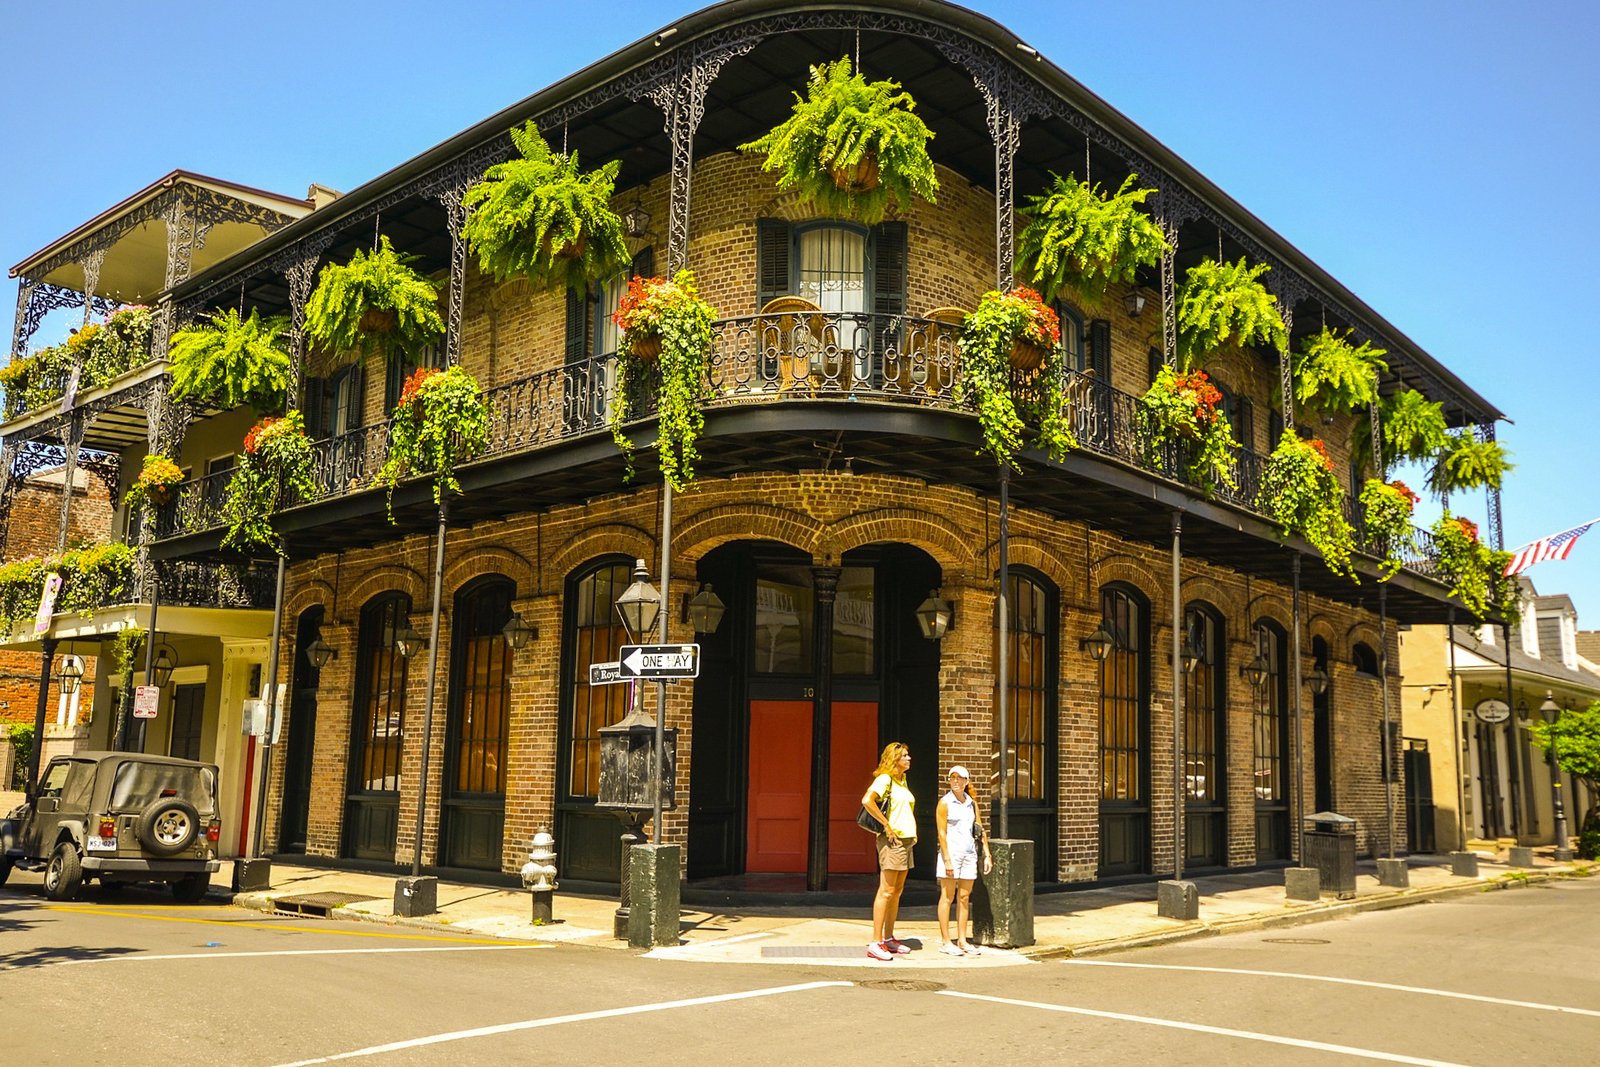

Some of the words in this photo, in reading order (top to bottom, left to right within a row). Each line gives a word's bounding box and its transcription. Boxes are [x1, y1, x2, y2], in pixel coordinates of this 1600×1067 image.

[642, 655, 663, 668] ONE
[600, 669, 620, 682] Roya
[803, 687, 814, 698] 10
